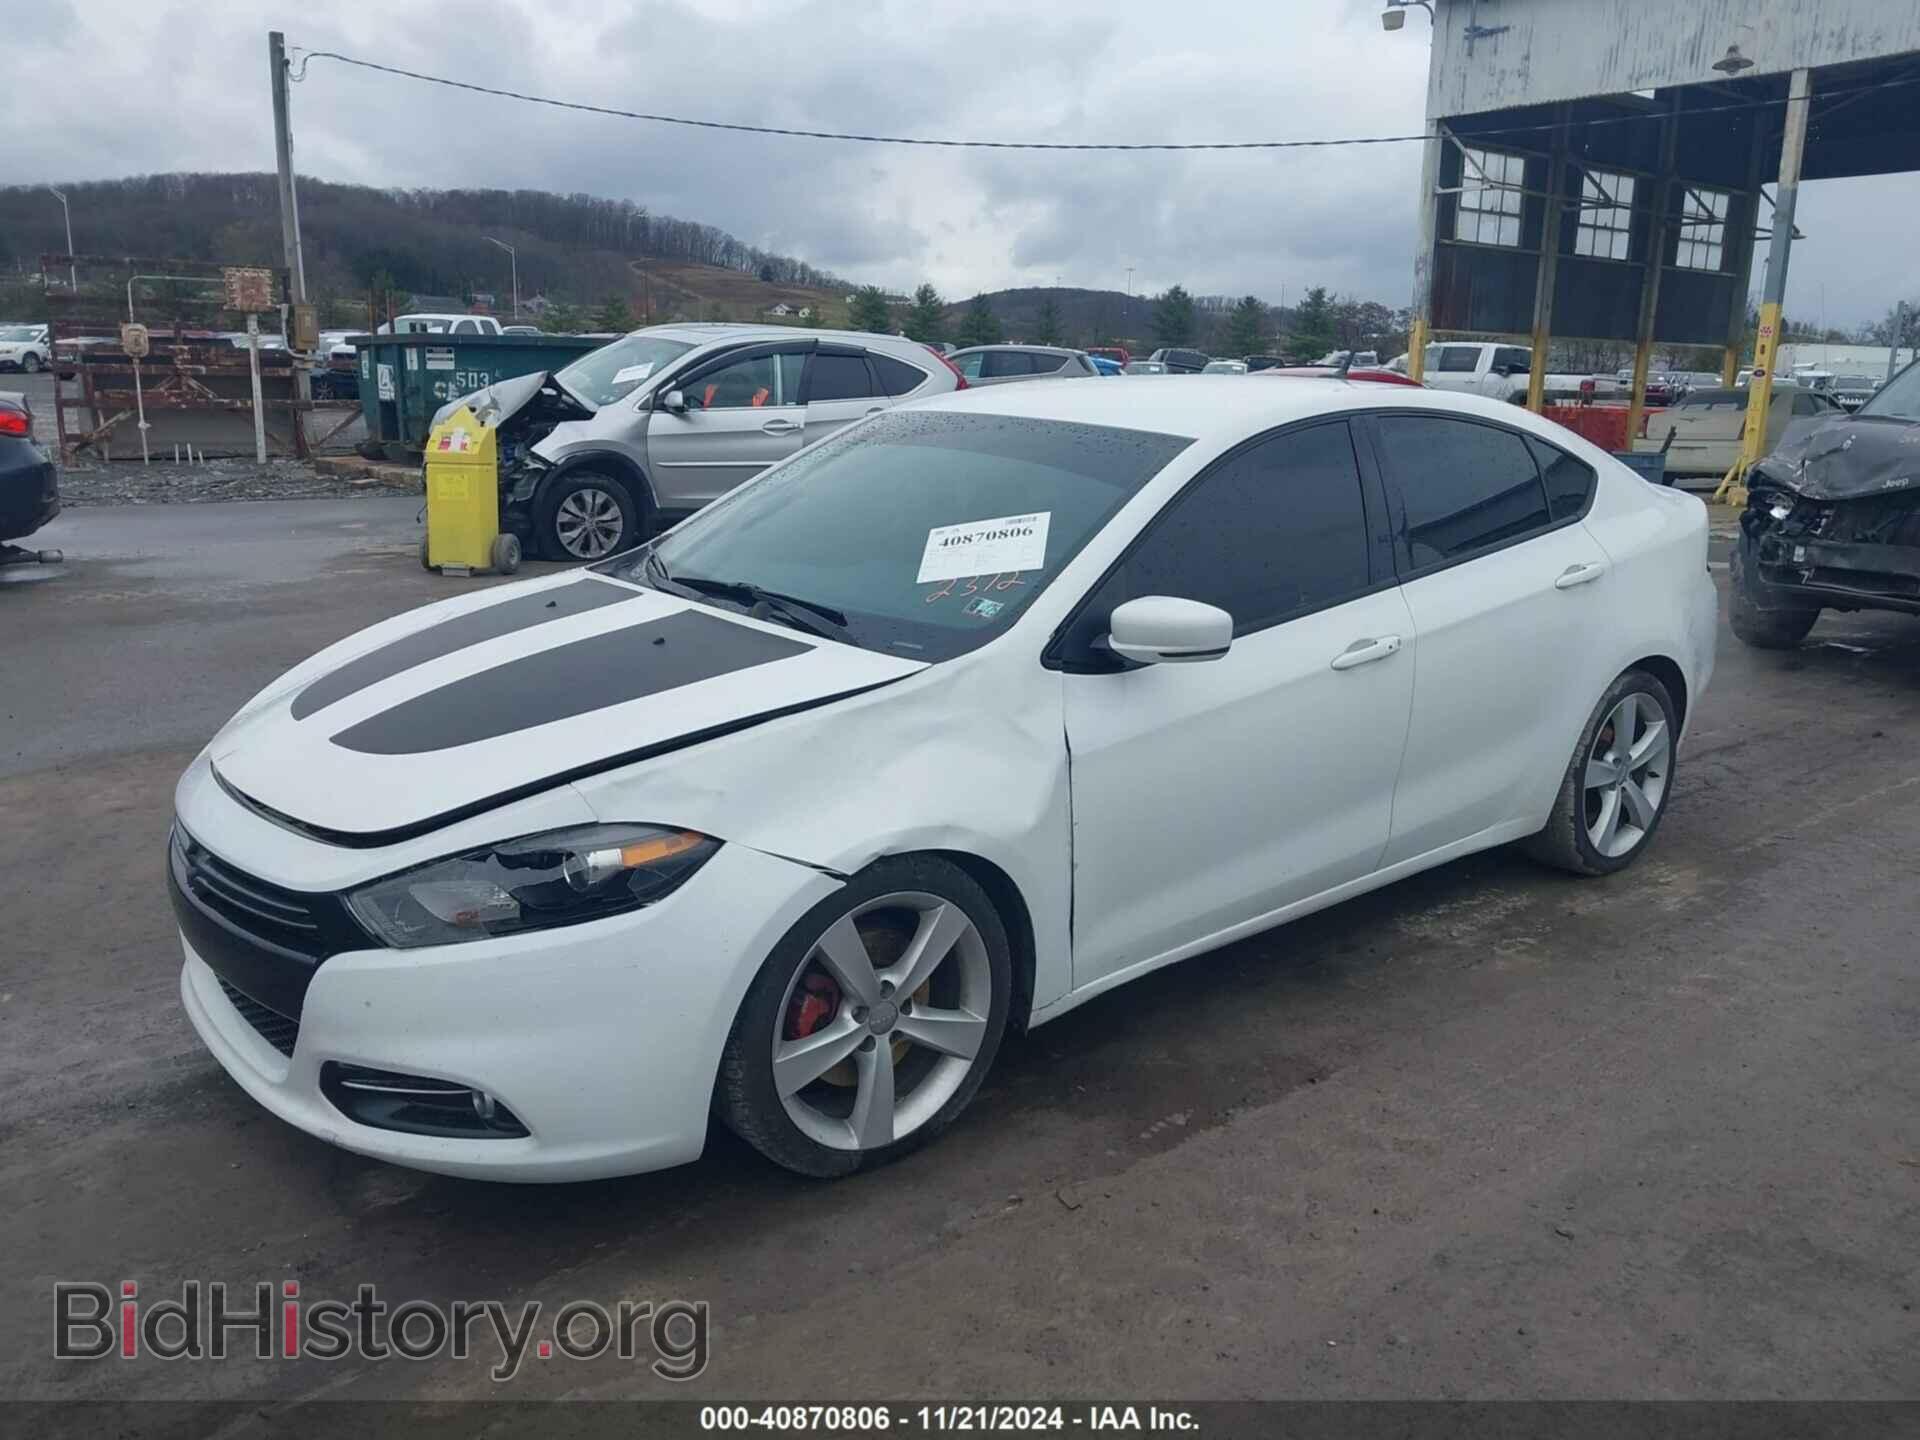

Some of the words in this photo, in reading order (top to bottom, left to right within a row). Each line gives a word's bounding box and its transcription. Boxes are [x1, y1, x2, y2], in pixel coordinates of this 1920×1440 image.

[455, 372, 489, 388] 503
[1880, 478, 1910, 489] Jeep
[938, 526, 1034, 547] 40870806
